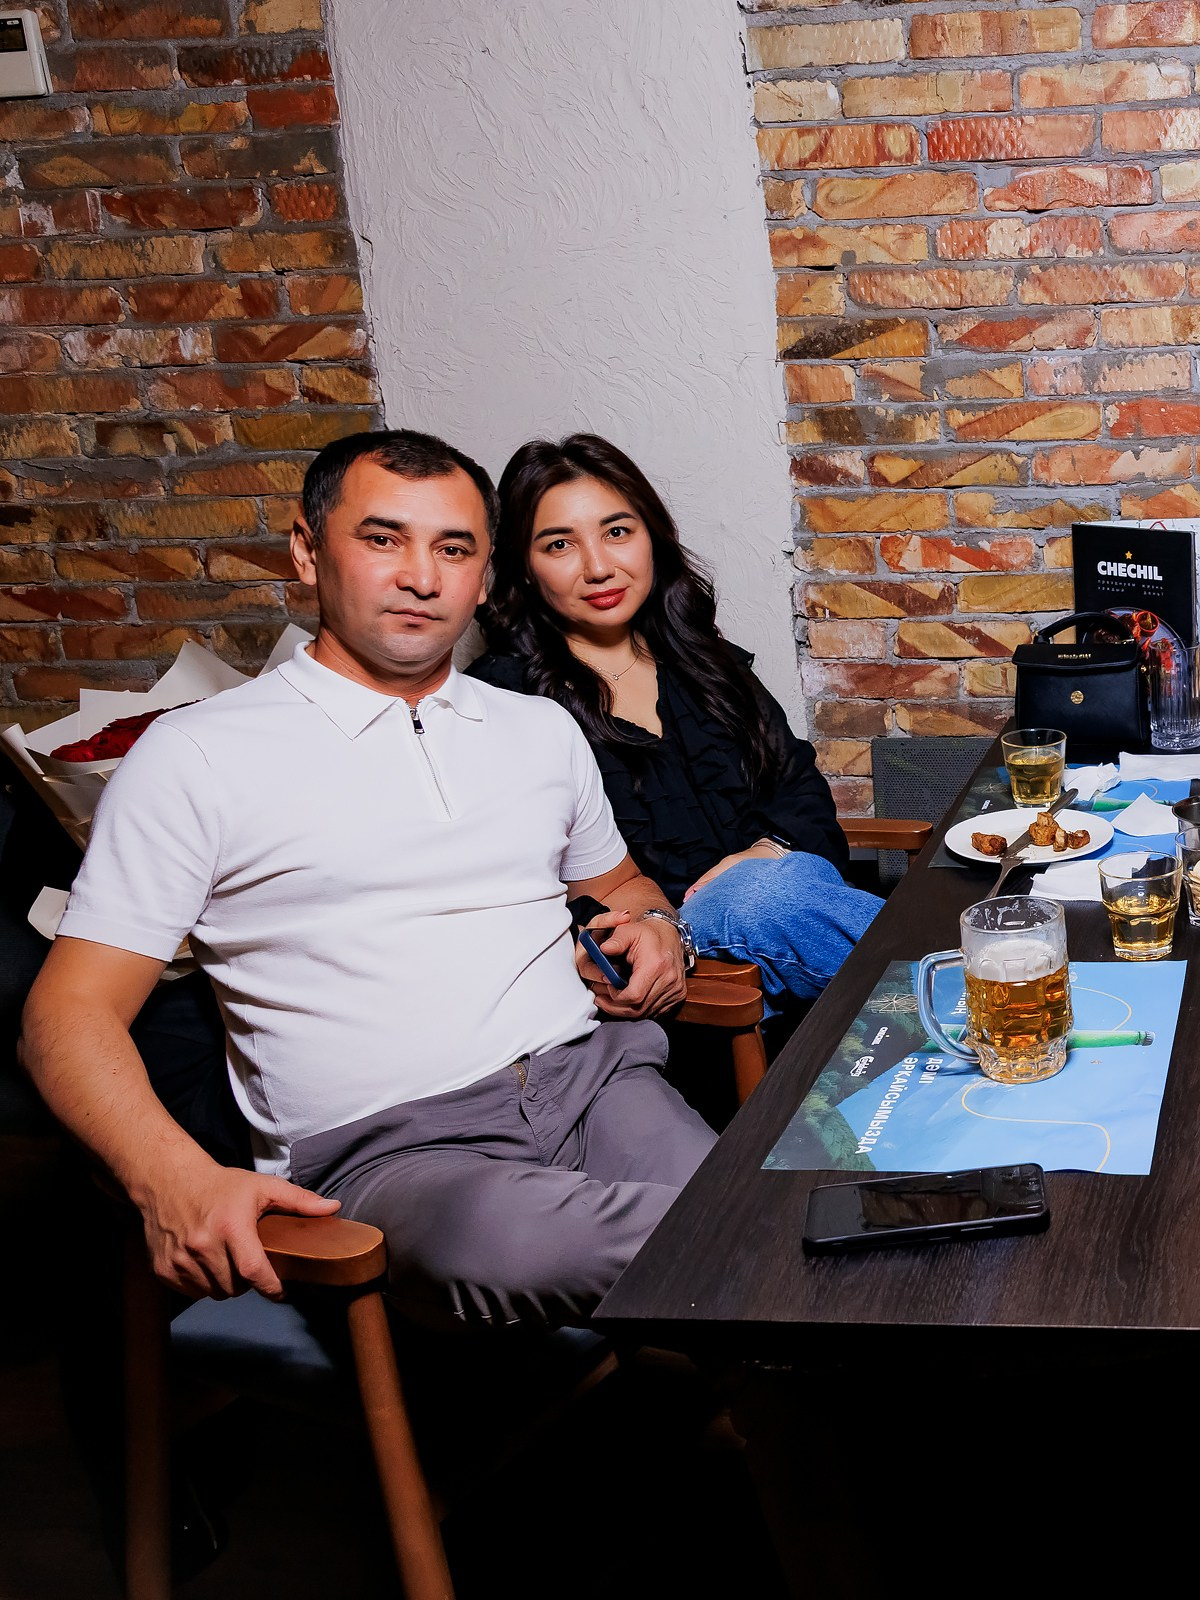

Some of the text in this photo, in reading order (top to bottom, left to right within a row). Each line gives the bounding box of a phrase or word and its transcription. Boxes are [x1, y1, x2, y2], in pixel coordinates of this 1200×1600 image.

[1097, 561, 1163, 581] CHECHIL
[919, 1057, 944, 1084] ДӘМІ
[854, 1057, 919, 1154] ӘРҚАЙСЫМЫЗДА
